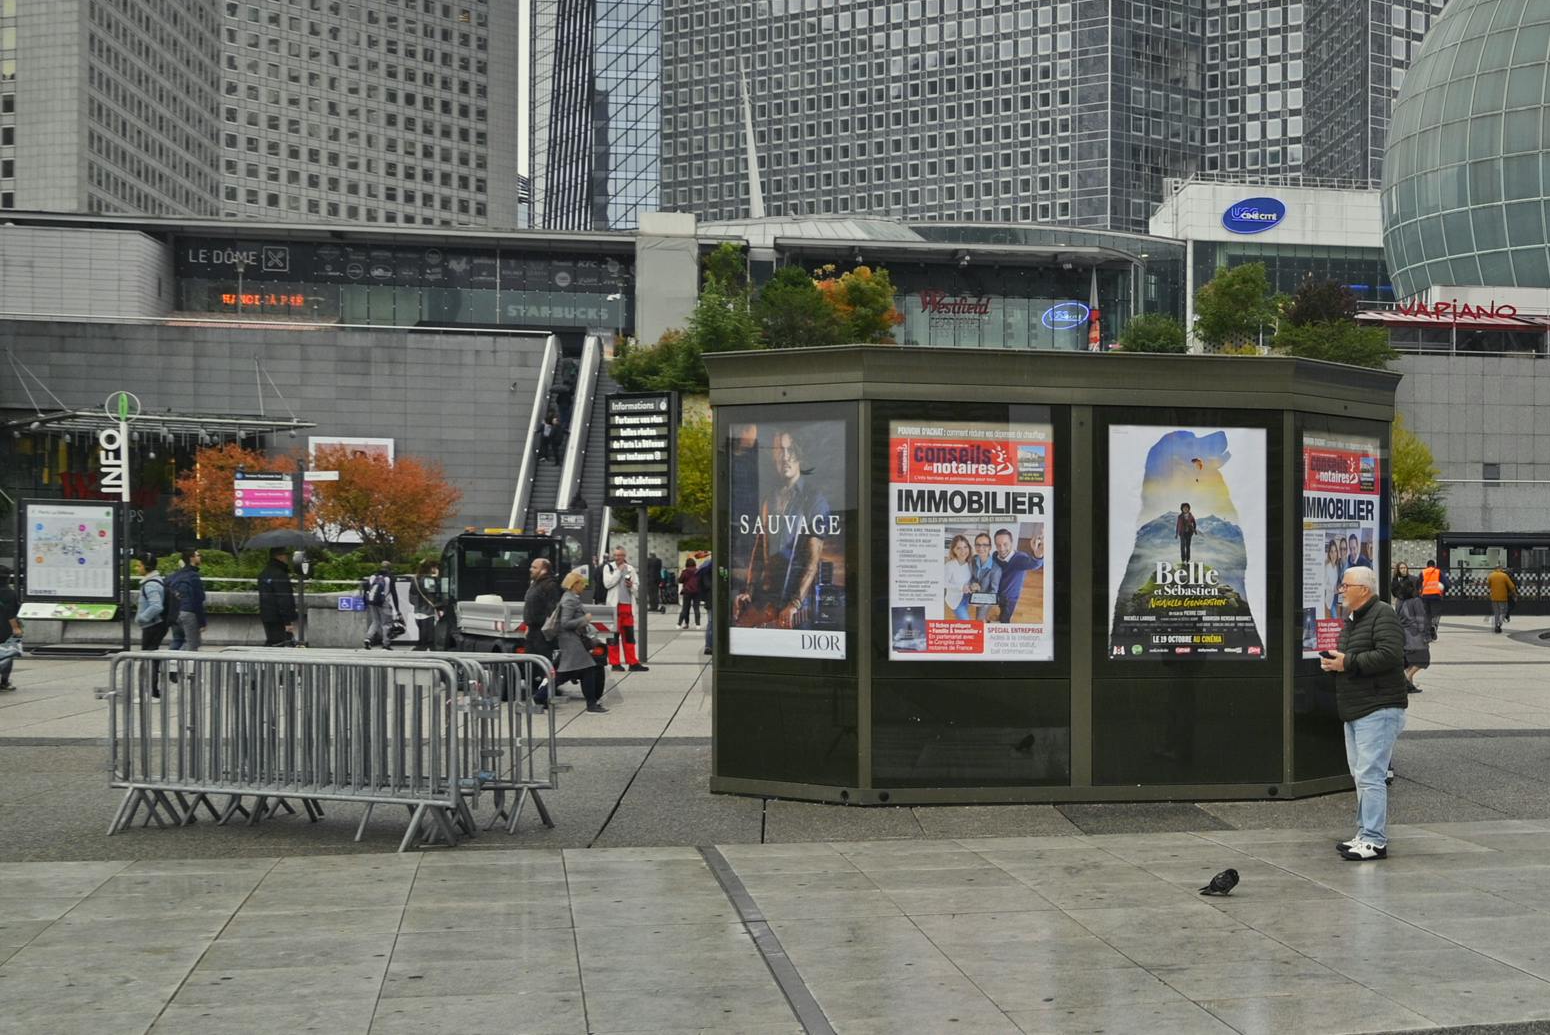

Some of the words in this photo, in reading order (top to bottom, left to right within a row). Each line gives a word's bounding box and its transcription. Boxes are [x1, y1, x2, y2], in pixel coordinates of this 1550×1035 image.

[188, 249, 208, 263] LE
[213, 247, 257, 265] DÔME
[919, 289, 992, 315] Westfield
[507, 304, 609, 320] STARBUCKS
[612, 400, 655, 411] Informations
[100, 428, 123, 494] INFO
[914, 444, 993, 465] conseils
[933, 461, 997, 475] notaires
[1320, 471, 1350, 484] notaires
[897, 488, 1045, 515] IMMOBILIER
[1303, 496, 1375, 521] IMMOBILIER
[740, 514, 841, 535] SAUVAGE
[1154, 561, 1220, 585] Belle
[1154, 588, 1163, 596] et
[1164, 584, 1219, 596] Sébastien
[987, 626, 1010, 634] SPÉCIAL
[1152, 635, 1160, 643] LE
[1160, 635, 1167, 643] 19
[1167, 635, 1193, 644] OCTOBRE
[1193, 635, 1201, 644] AU
[1201, 634, 1222, 644] CINÉMA
[801, 634, 841, 652] DIOR
